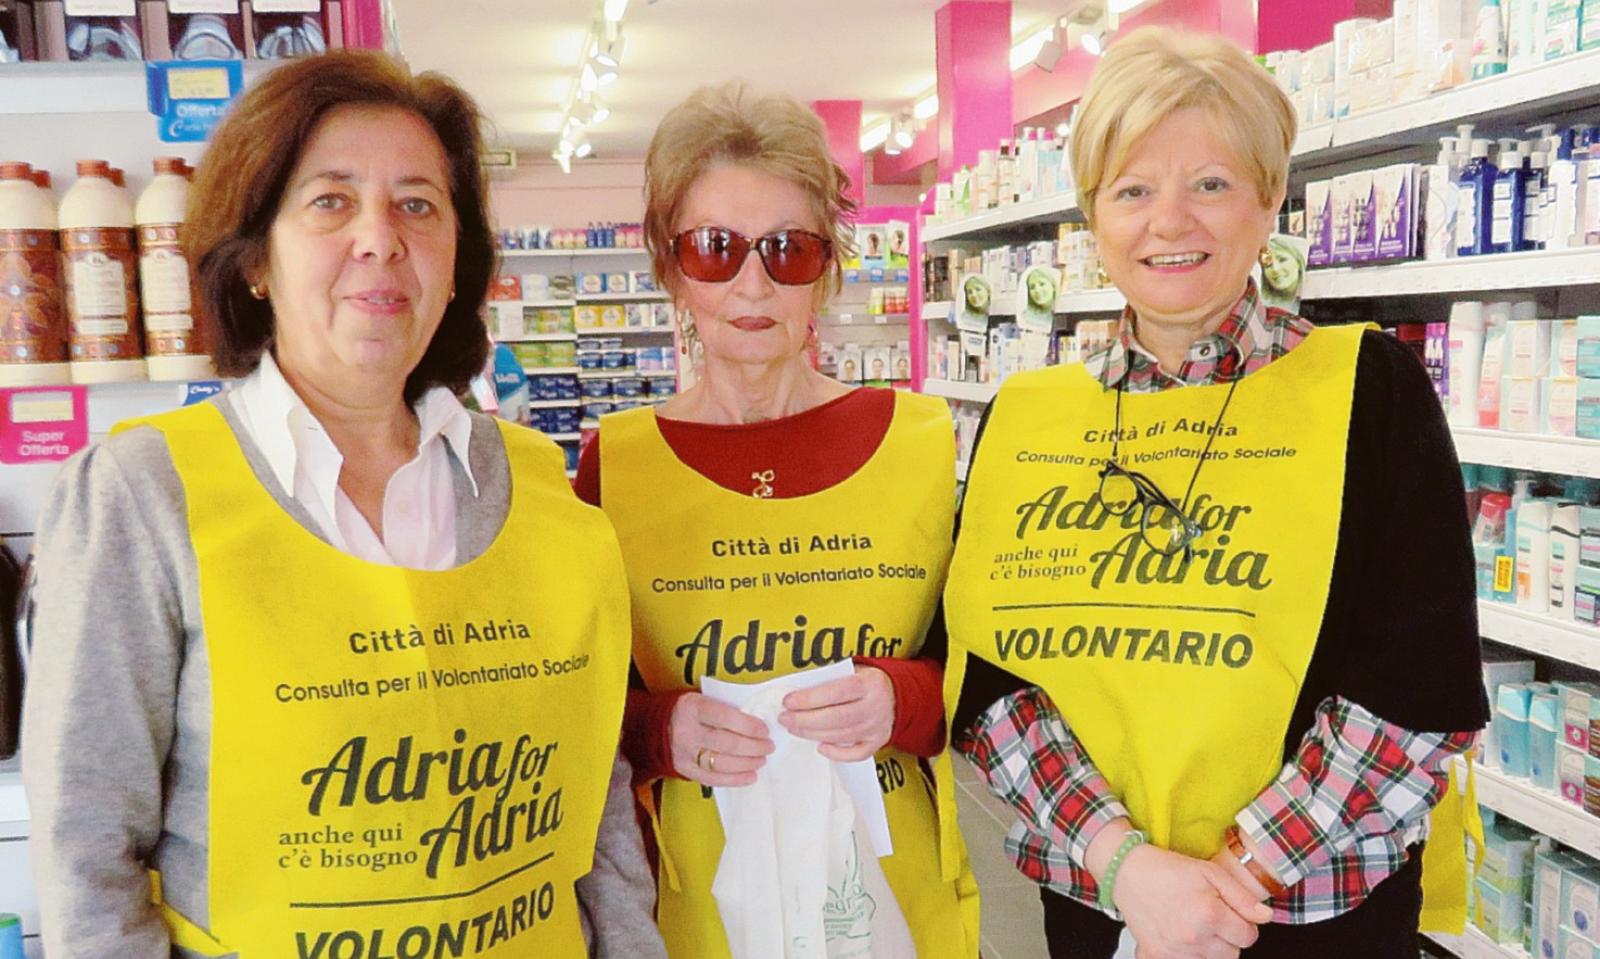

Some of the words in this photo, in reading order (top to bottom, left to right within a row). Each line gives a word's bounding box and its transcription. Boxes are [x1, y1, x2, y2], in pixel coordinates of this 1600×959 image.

[22, 431, 65, 444] Super
[1084, 426, 1137, 443] Città
[1146, 421, 1166, 437] di
[1173, 418, 1238, 437] Adria
[18, 444, 70, 456] Offerta
[1016, 451, 1084, 465] Consulta
[1121, 455, 1128, 465] il
[1134, 446, 1228, 462] Volontariato
[1233, 447, 1296, 458] Sociale
[1016, 486, 1192, 539] Adria
[1191, 494, 1252, 532] for
[712, 537, 770, 557] Città
[780, 537, 799, 554] di
[810, 534, 872, 552] Adria
[994, 546, 1044, 563] anche
[1049, 545, 1077, 559] qui
[1018, 564, 1086, 580] bisogno
[1089, 532, 1272, 590] Adria
[652, 577, 725, 592] Consulta
[731, 577, 757, 592] per
[763, 574, 771, 586] il
[775, 567, 874, 585] Volontariato
[879, 564, 926, 579] Sociale
[350, 625, 424, 653] Città
[434, 624, 453, 645] di
[465, 620, 531, 643] Adria
[676, 615, 853, 685] Adria
[854, 624, 902, 657] for
[994, 625, 1253, 669] VOLONTARIO
[276, 679, 369, 702] Consulta
[377, 673, 411, 697] per
[417, 672, 426, 689] il
[432, 660, 538, 688] Volontariato
[543, 654, 589, 676] Sociale
[301, 729, 509, 816] Adria
[498, 734, 557, 800] for
[279, 825, 354, 845] anche
[363, 824, 402, 849] qui
[419, 781, 563, 879] Adria
[321, 849, 417, 871] bisogno
[295, 881, 554, 959] VOLONTARIO
